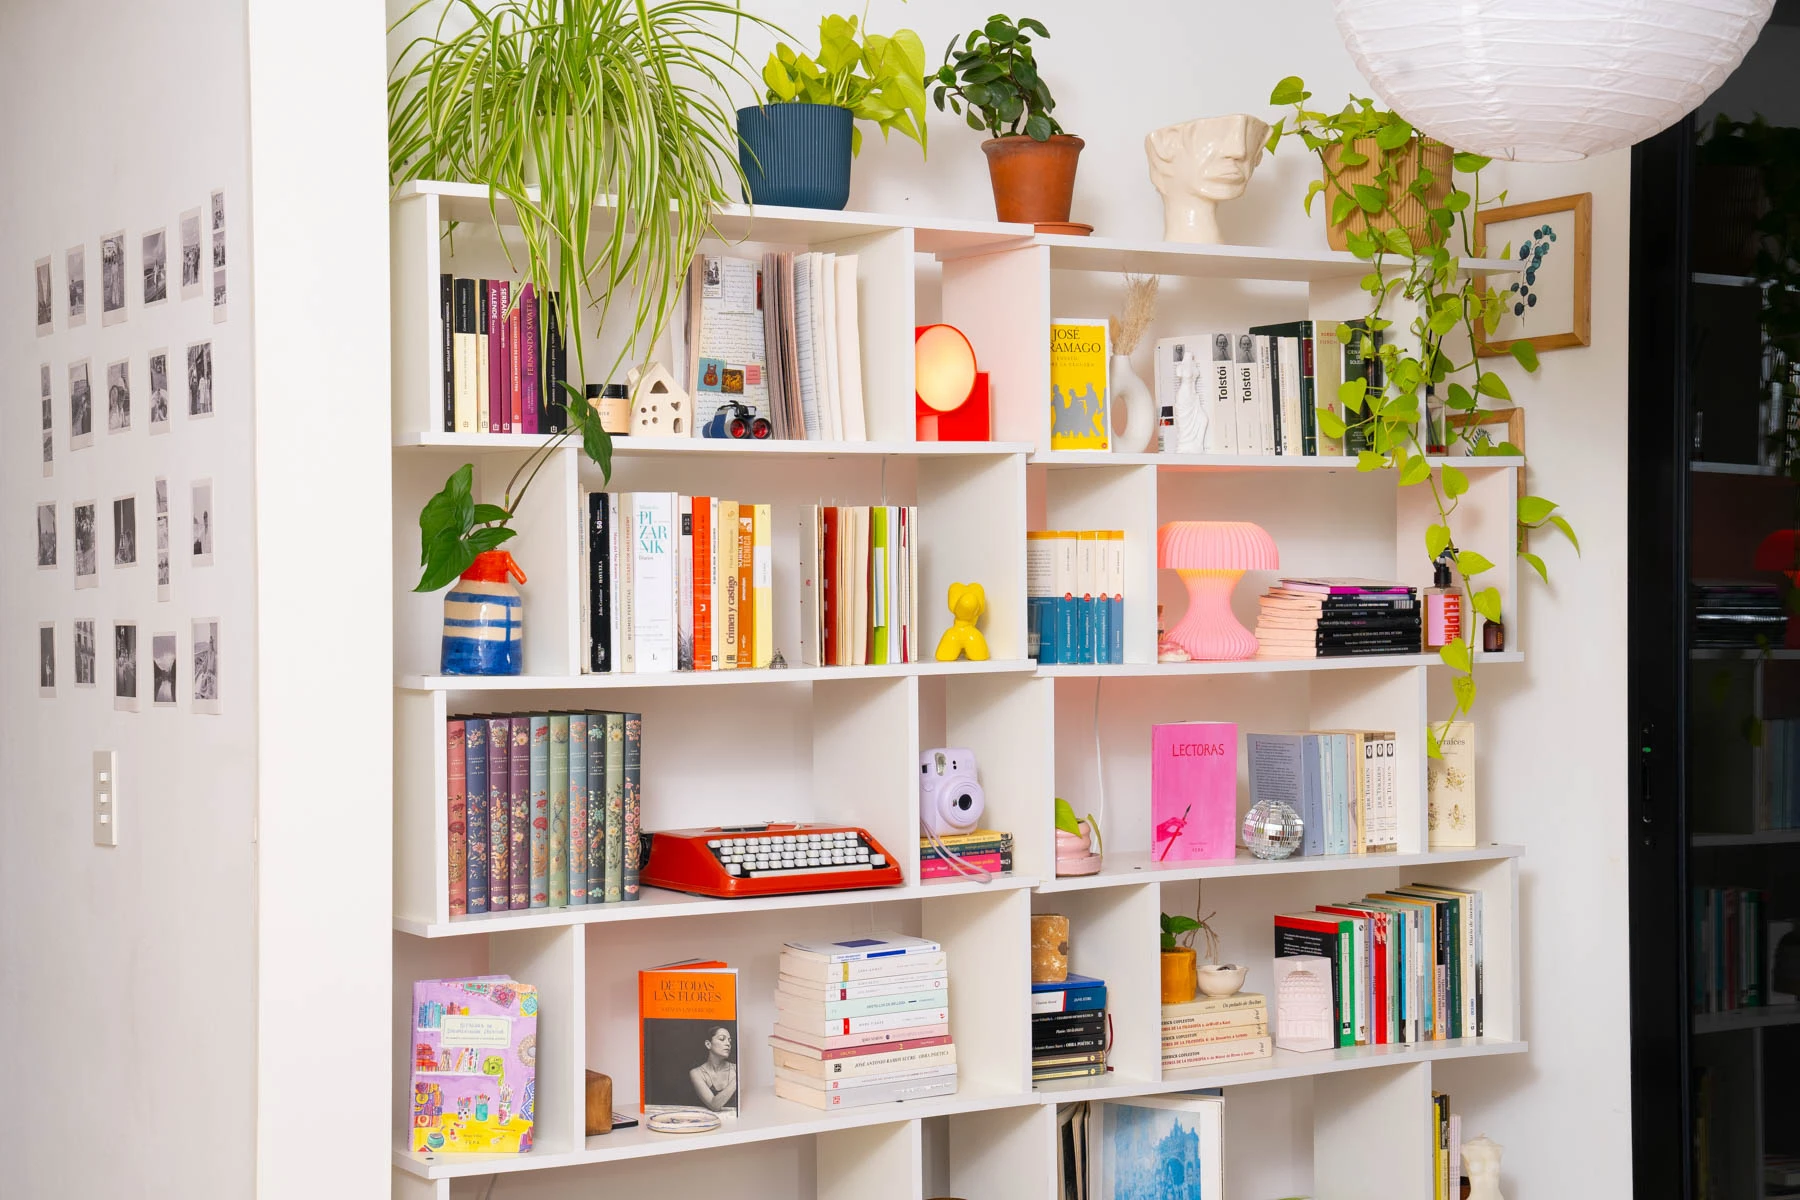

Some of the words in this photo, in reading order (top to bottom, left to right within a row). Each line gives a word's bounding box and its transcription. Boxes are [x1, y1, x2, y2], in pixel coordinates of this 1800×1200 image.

[526, 298, 534, 330] SAVATER
[1054, 326, 1081, 342] JOSÉ
[526, 331, 534, 376] FERNANDO
[1050, 342, 1101, 353] RAMAGO
[1217, 366, 1228, 402] Tolstói
[1240, 368, 1252, 404] Tolstói
[726, 575, 738, 606] castigo
[726, 611, 735, 645] Crimen
[1172, 743, 1225, 757] LECTORAS
[1443, 737, 1466, 746] raíces
[653, 991, 676, 1001] LAS
[678, 991, 722, 1003] FLORES
[660, 980, 676, 991] DE
[678, 980, 715, 992] TODAS
